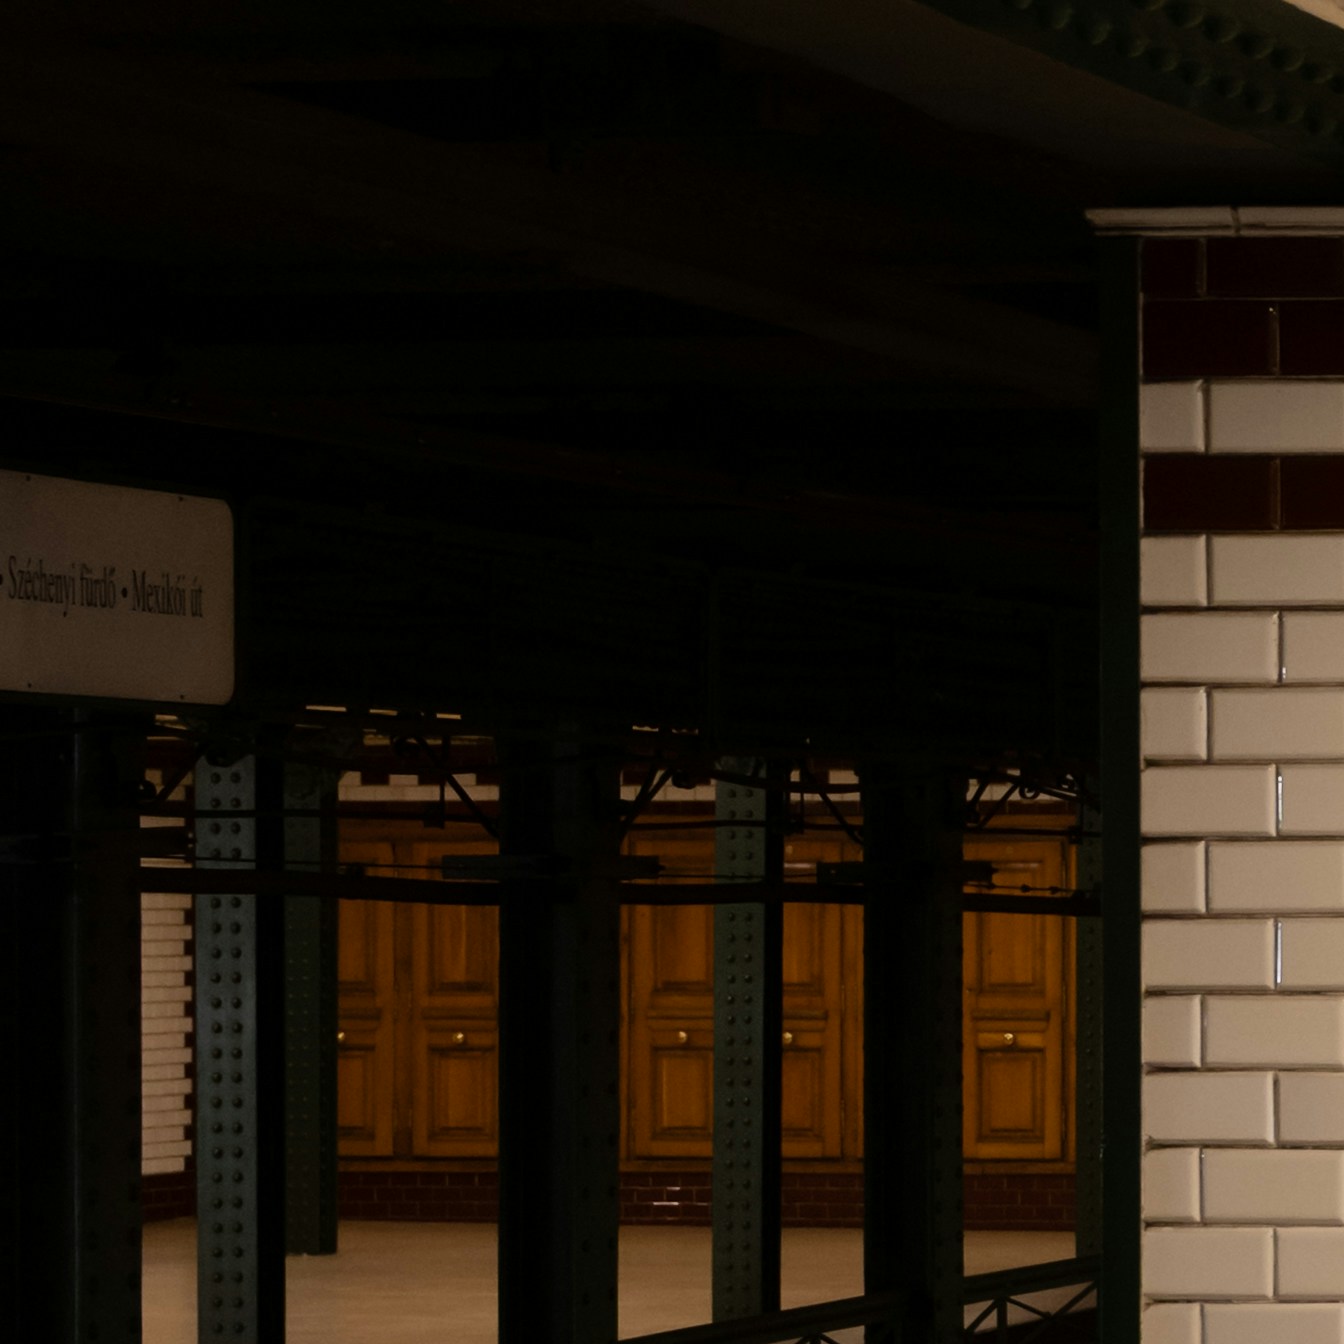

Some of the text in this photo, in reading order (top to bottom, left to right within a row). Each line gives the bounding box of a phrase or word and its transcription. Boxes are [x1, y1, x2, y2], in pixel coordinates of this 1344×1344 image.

[8, 555, 204, 618] Széchenyi fürdő Mexikói út
